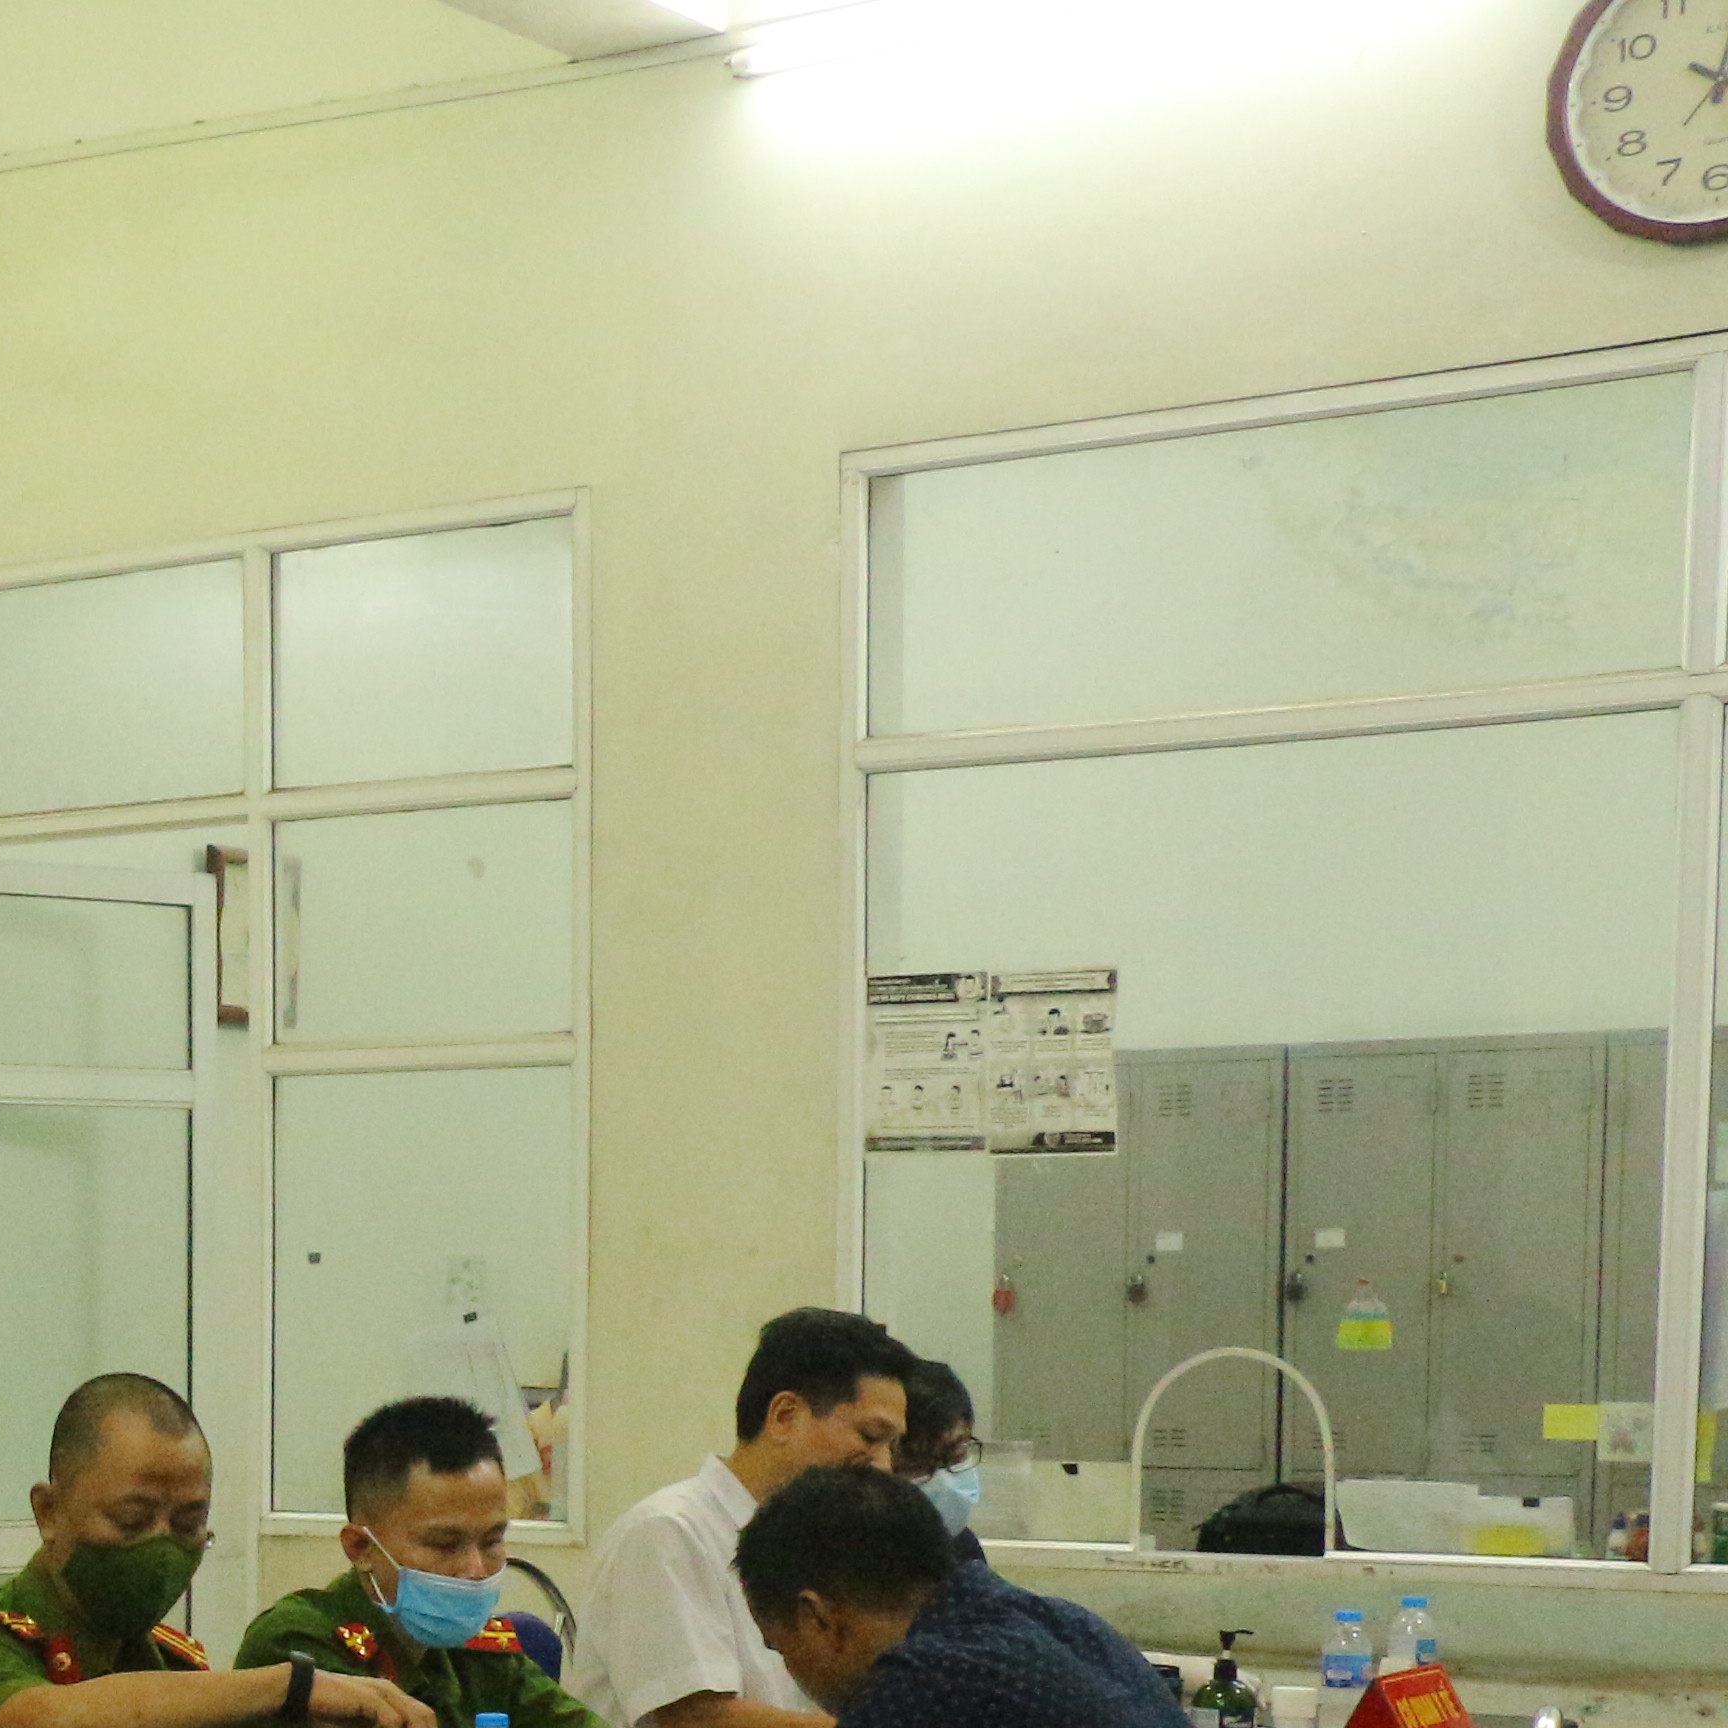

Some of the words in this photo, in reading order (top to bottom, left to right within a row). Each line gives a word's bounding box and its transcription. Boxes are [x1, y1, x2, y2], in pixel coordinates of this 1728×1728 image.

[1619, 33, 1656, 62] 10
[1602, 85, 1632, 112] 9
[1617, 130, 1647, 157] 8
[1656, 157, 1682, 186] 7
